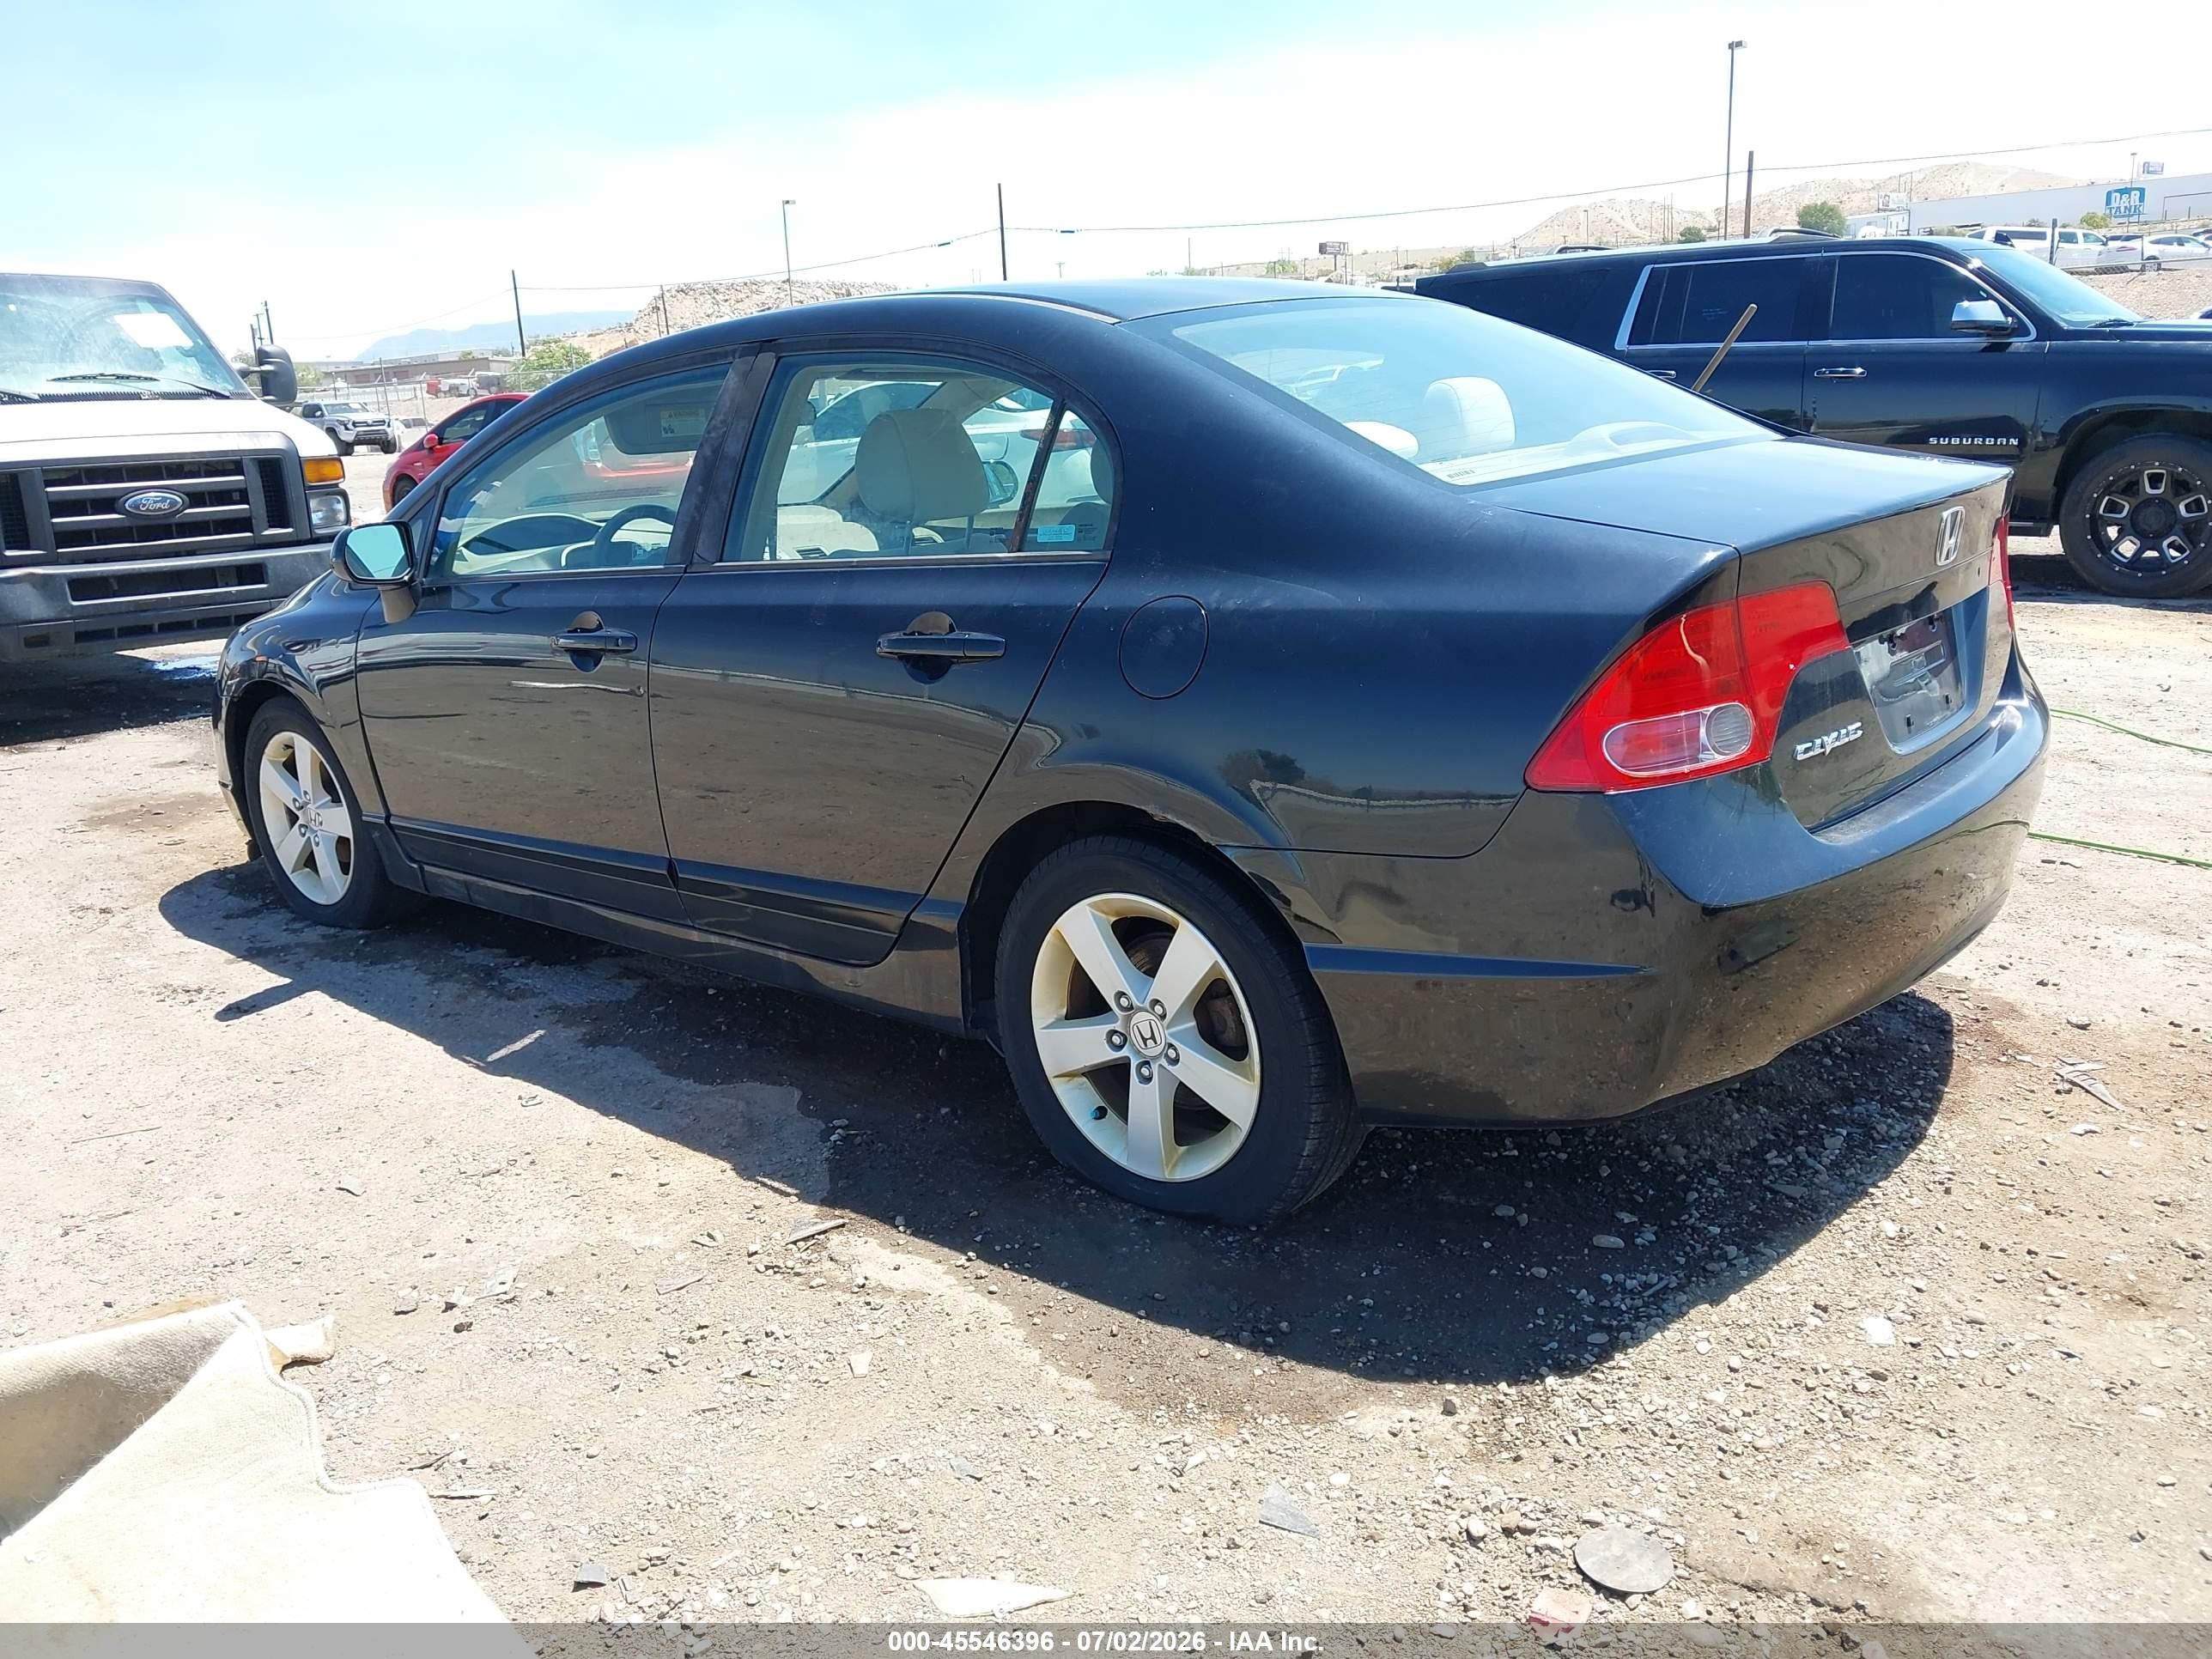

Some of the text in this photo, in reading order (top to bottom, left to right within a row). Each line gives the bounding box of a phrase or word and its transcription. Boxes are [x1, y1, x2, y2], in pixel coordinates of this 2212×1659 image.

[2110, 190, 2141, 206] D&R
[2106, 204, 2144, 216] TANK
[1929, 437, 2019, 446] SUBURBAN
[139, 497, 171, 511] Ford
[1793, 721, 1863, 761] CIVIC
